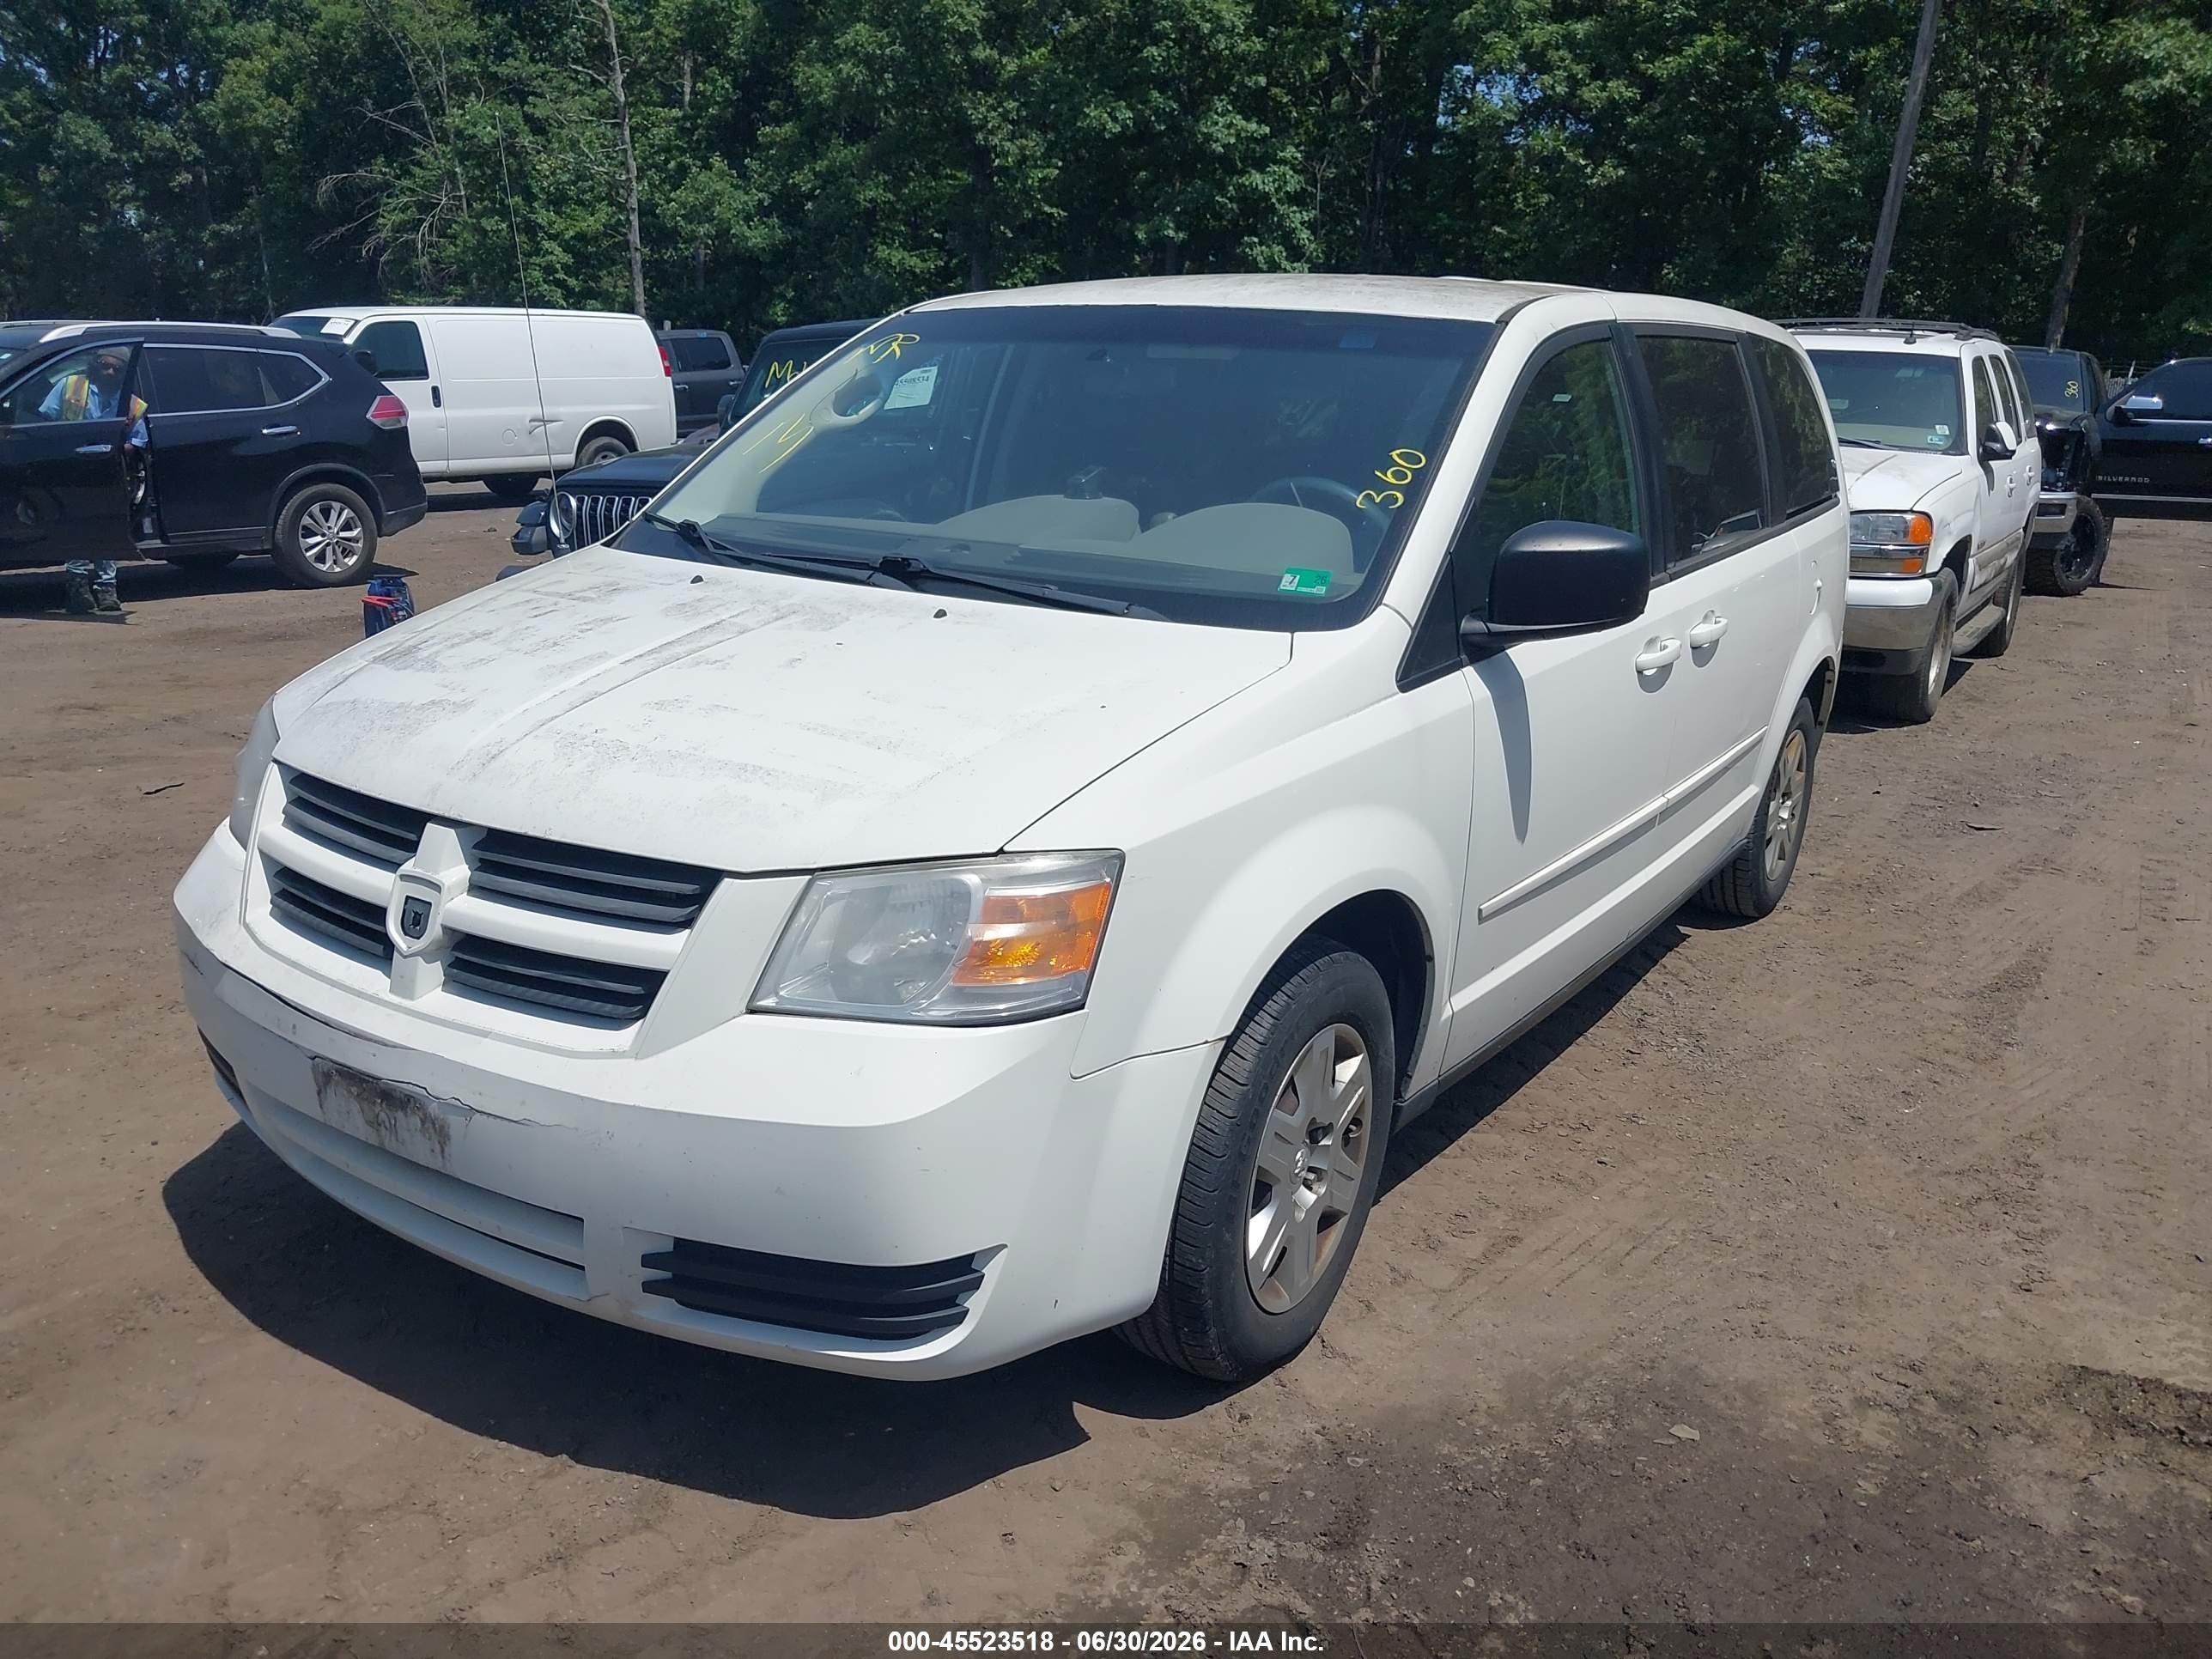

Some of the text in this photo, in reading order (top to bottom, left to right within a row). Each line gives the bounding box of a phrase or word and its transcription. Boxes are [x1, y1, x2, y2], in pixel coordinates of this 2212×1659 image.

[1355, 448, 1427, 509] 360
[1288, 574, 1328, 586] 7 26
